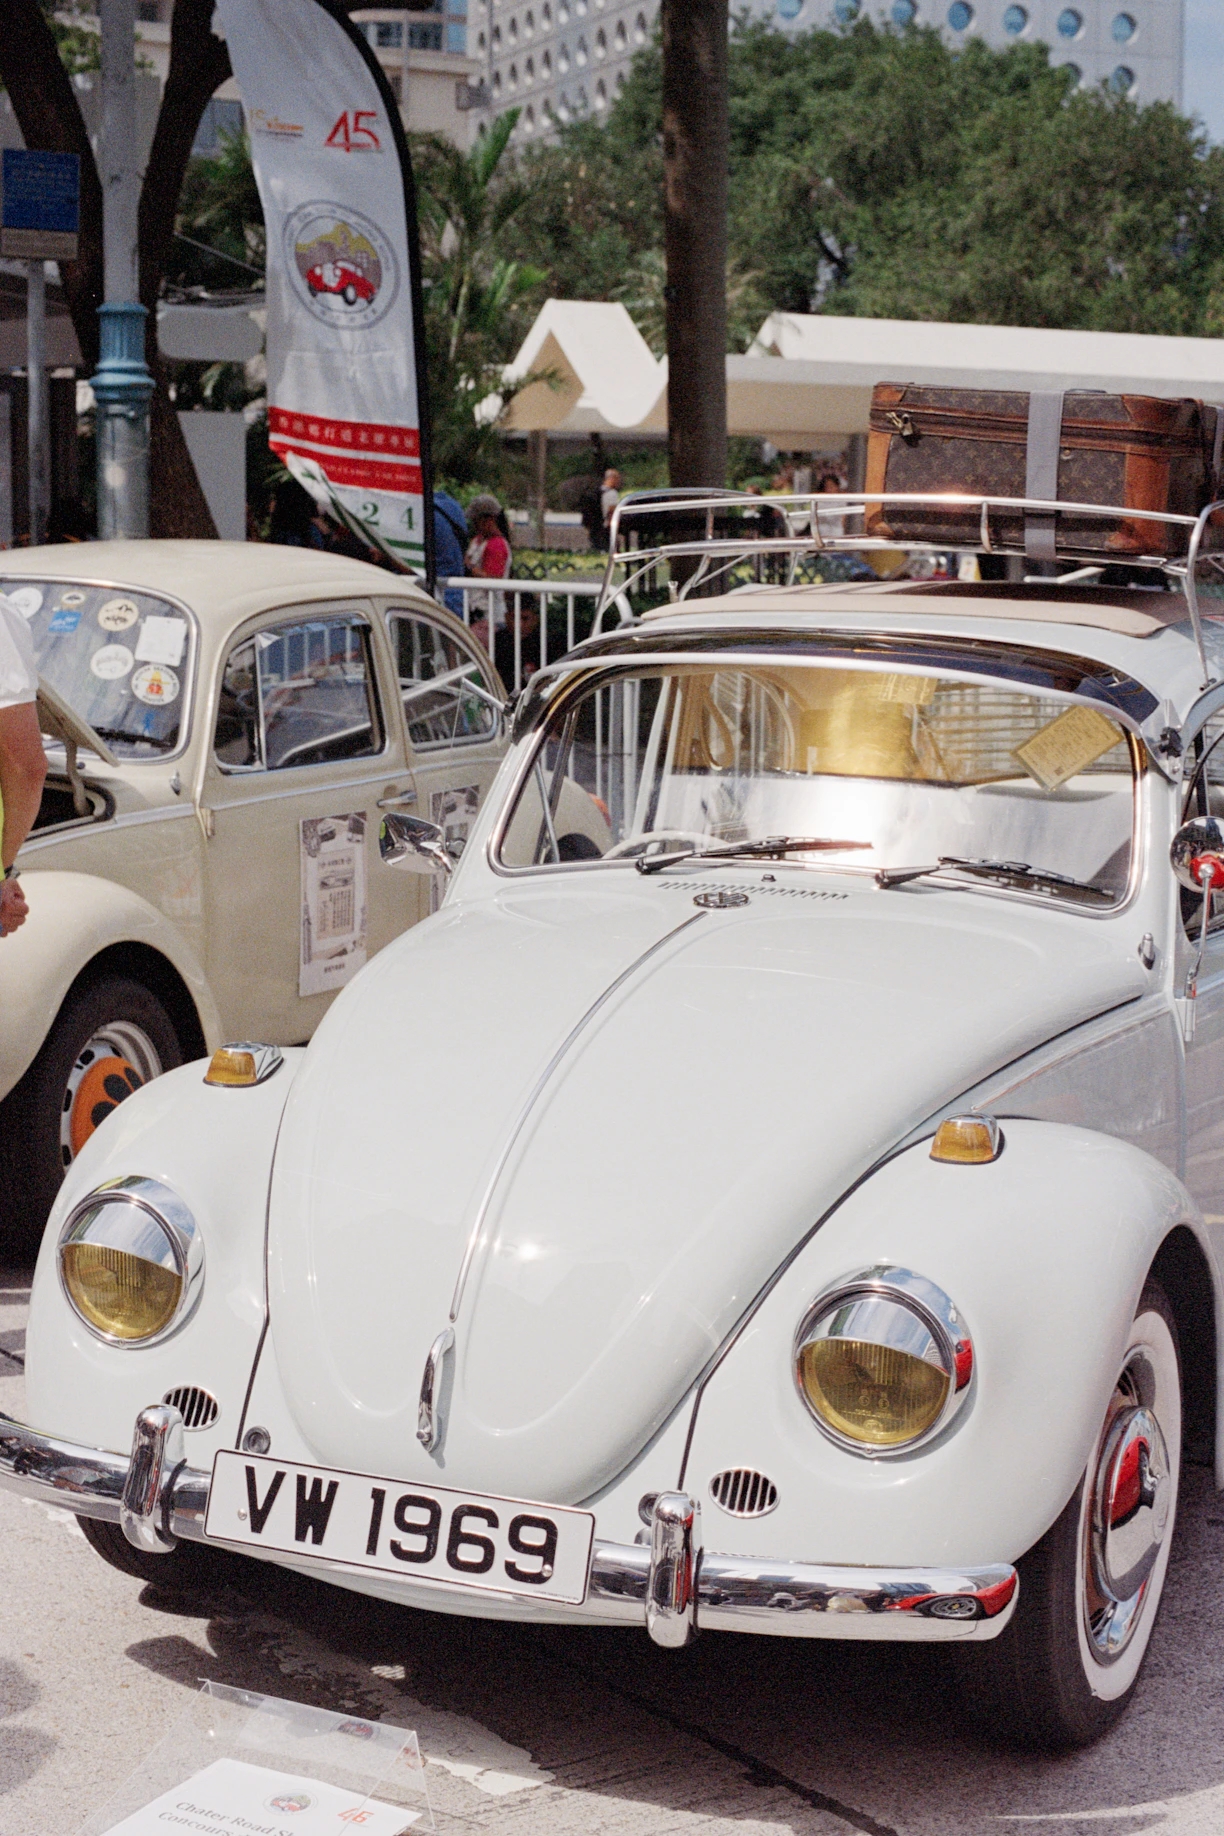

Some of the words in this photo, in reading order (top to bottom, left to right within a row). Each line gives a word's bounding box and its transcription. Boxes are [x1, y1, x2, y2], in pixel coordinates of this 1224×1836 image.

[324, 110, 380, 152] 45
[245, 1465, 339, 1545] VW
[365, 1487, 558, 1584] 1969
[158, 1811, 234, 1836] Concours
[175, 1801, 230, 1822] Chater
[230, 1816, 276, 1834] Road
